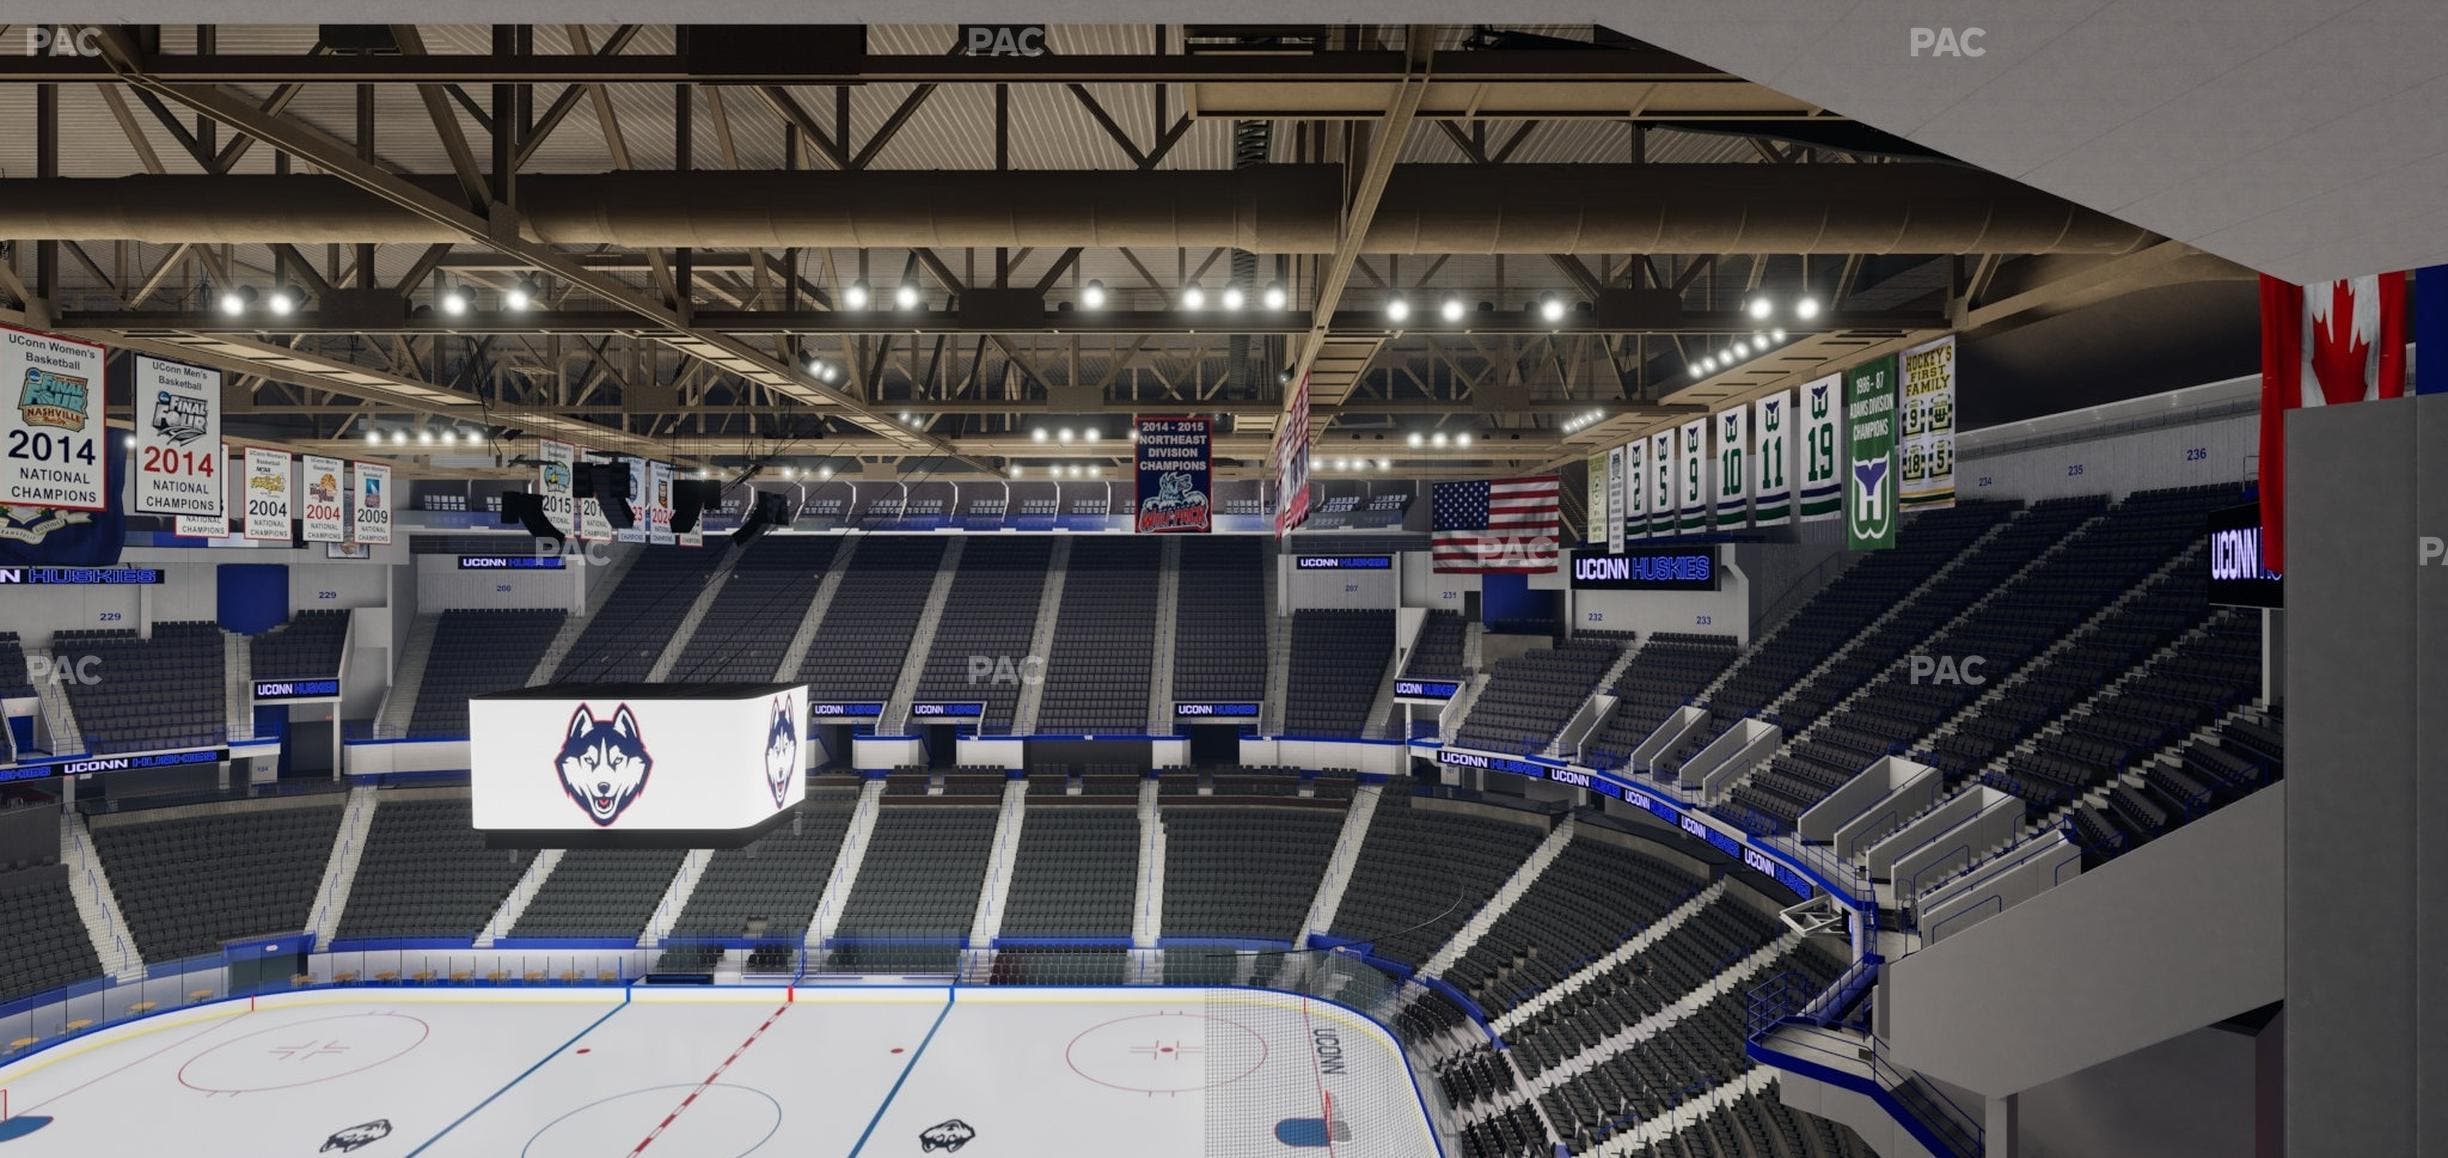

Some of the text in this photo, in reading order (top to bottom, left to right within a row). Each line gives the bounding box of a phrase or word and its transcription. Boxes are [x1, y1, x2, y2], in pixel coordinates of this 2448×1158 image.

[9, 334, 95, 359] UConn Women's
[26, 352, 80, 370] Basketball
[1905, 345, 1953, 373] HOCKEY'S
[152, 362, 208, 380] UConn Men's
[1910, 364, 1946, 383] FIRST
[158, 376, 202, 391] Basketball
[1856, 376, 1871, 394] 1986
[1876, 371, 1885, 390] 87
[1905, 374, 1951, 397] FAMILY
[27, 408, 81, 423] NASHVILLE
[1909, 409, 1918, 428] 9
[1142, 422, 1169, 432] 2014
[1178, 422, 1204, 432] 2015
[1853, 418, 1889, 441] CHAMPIONS
[8, 430, 96, 465] 2014
[1139, 435, 1207, 445] NORTHEAST
[1148, 448, 1198, 458] DIVISION
[1807, 421, 1834, 482] 19
[1936, 450, 1945, 469] 5
[2186, 448, 2207, 461] 236
[144, 446, 214, 478] 2014
[1139, 461, 1207, 471] CHAMPIONS
[1762, 435, 1784, 489] 11
[1907, 453, 1920, 474] 18
[20, 468, 90, 484] NATIONAL
[1722, 448, 1742, 496] 10
[2068, 464, 2083, 477] 235
[1659, 465, 1667, 506] 5
[1689, 457, 1698, 501] 9
[1978, 476, 1992, 487] 234
[11, 486, 97, 502] CHAMPIONS
[153, 480, 209, 495] NATIONAL
[1633, 472, 1641, 511] 2
[146, 496, 214, 511] CHAMPIONS
[249, 500, 287, 517] 2004
[543, 496, 571, 514] 2015
[307, 504, 340, 521] 2004
[358, 508, 388, 524] 2009
[182, 525, 225, 535] CHAMPIONS
[254, 519, 285, 528] NATIONAL
[250, 529, 288, 537] CHAMPIONS
[2211, 527, 2257, 580] UCONN
[463, 558, 506, 567] UCONN
[1300, 558, 1338, 568] UCONN
[1576, 556, 1710, 580] UCONN HUSKIES
[28, 568, 156, 583] HUSKIES
[318, 591, 337, 599] 229
[100, 612, 122, 621] 229
[1588, 612, 1603, 622] 232
[1696, 615, 1712, 625] 233
[257, 683, 293, 695] UCONN
[1396, 683, 1423, 695] UCONN
[814, 705, 844, 715] UCONN
[915, 705, 944, 715] UCONN
[1178, 705, 1212, 715] UCONN
[64, 759, 128, 774] UCONN
[1440, 751, 1488, 768] UCONN
[1551, 768, 1590, 787] UCONN
[1624, 789, 1650, 810] UCONN
[1681, 814, 1706, 840] UCONN
[1744, 847, 1776, 877] UCONN
[1313, 1028, 1348, 1075] UCONN
